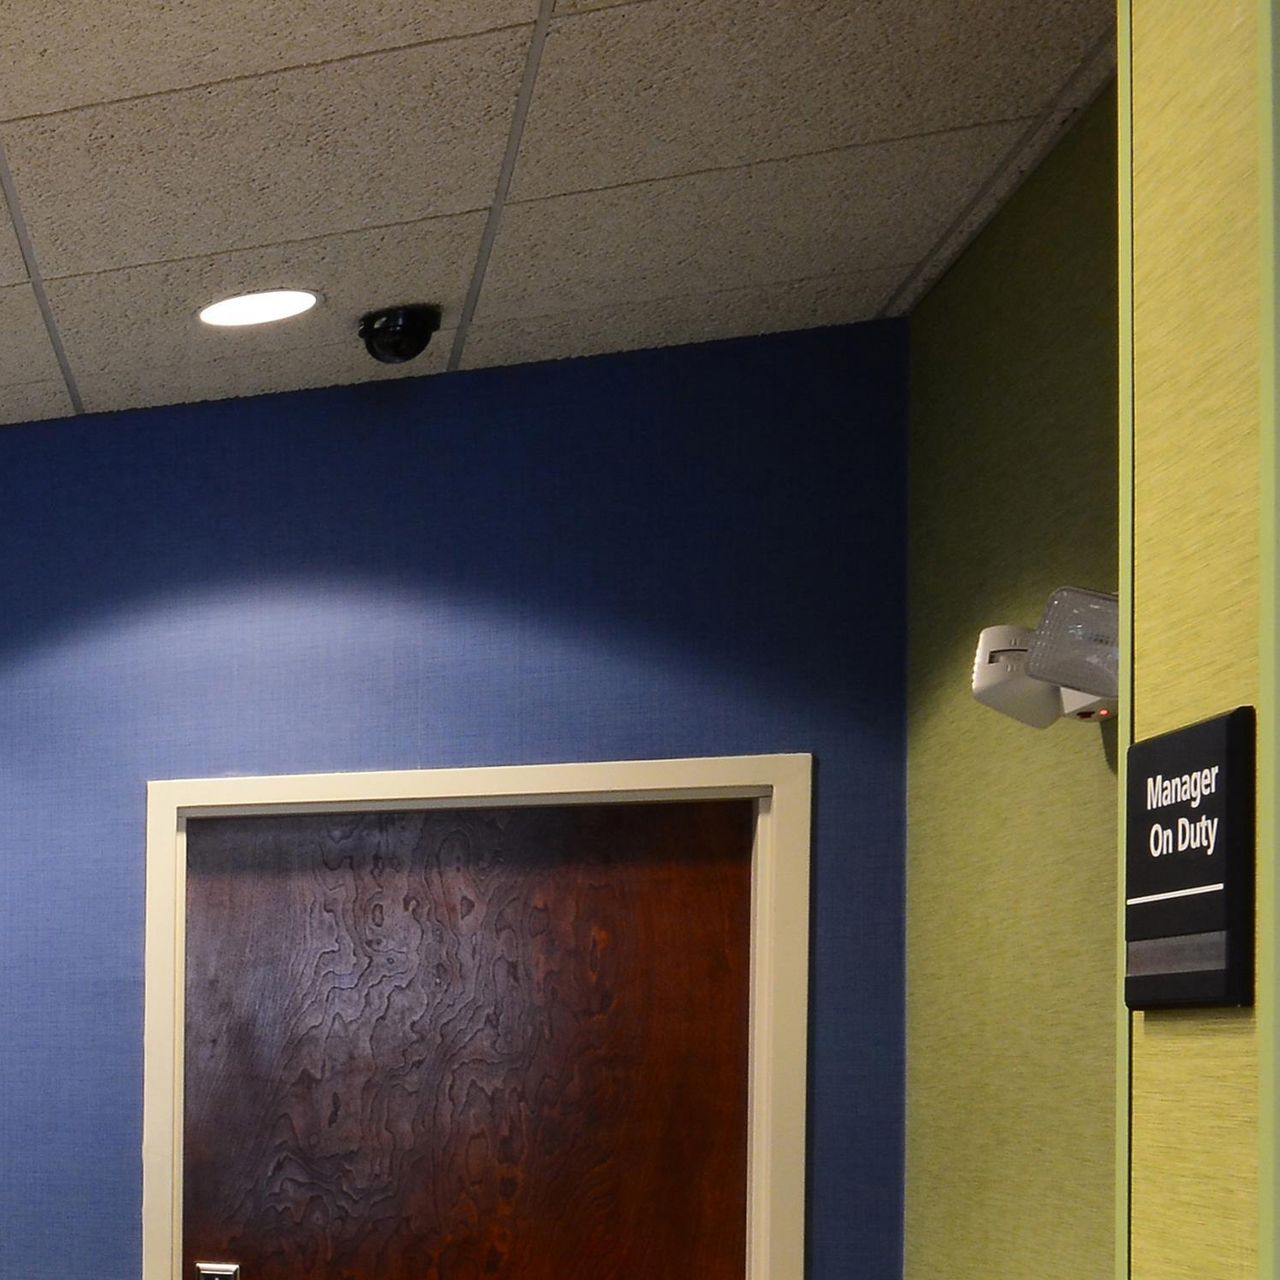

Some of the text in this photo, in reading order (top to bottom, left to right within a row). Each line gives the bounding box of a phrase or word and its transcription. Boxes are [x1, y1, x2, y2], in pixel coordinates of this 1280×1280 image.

[1146, 764, 1219, 811] Manager
[1149, 814, 1219, 858] On Duty
